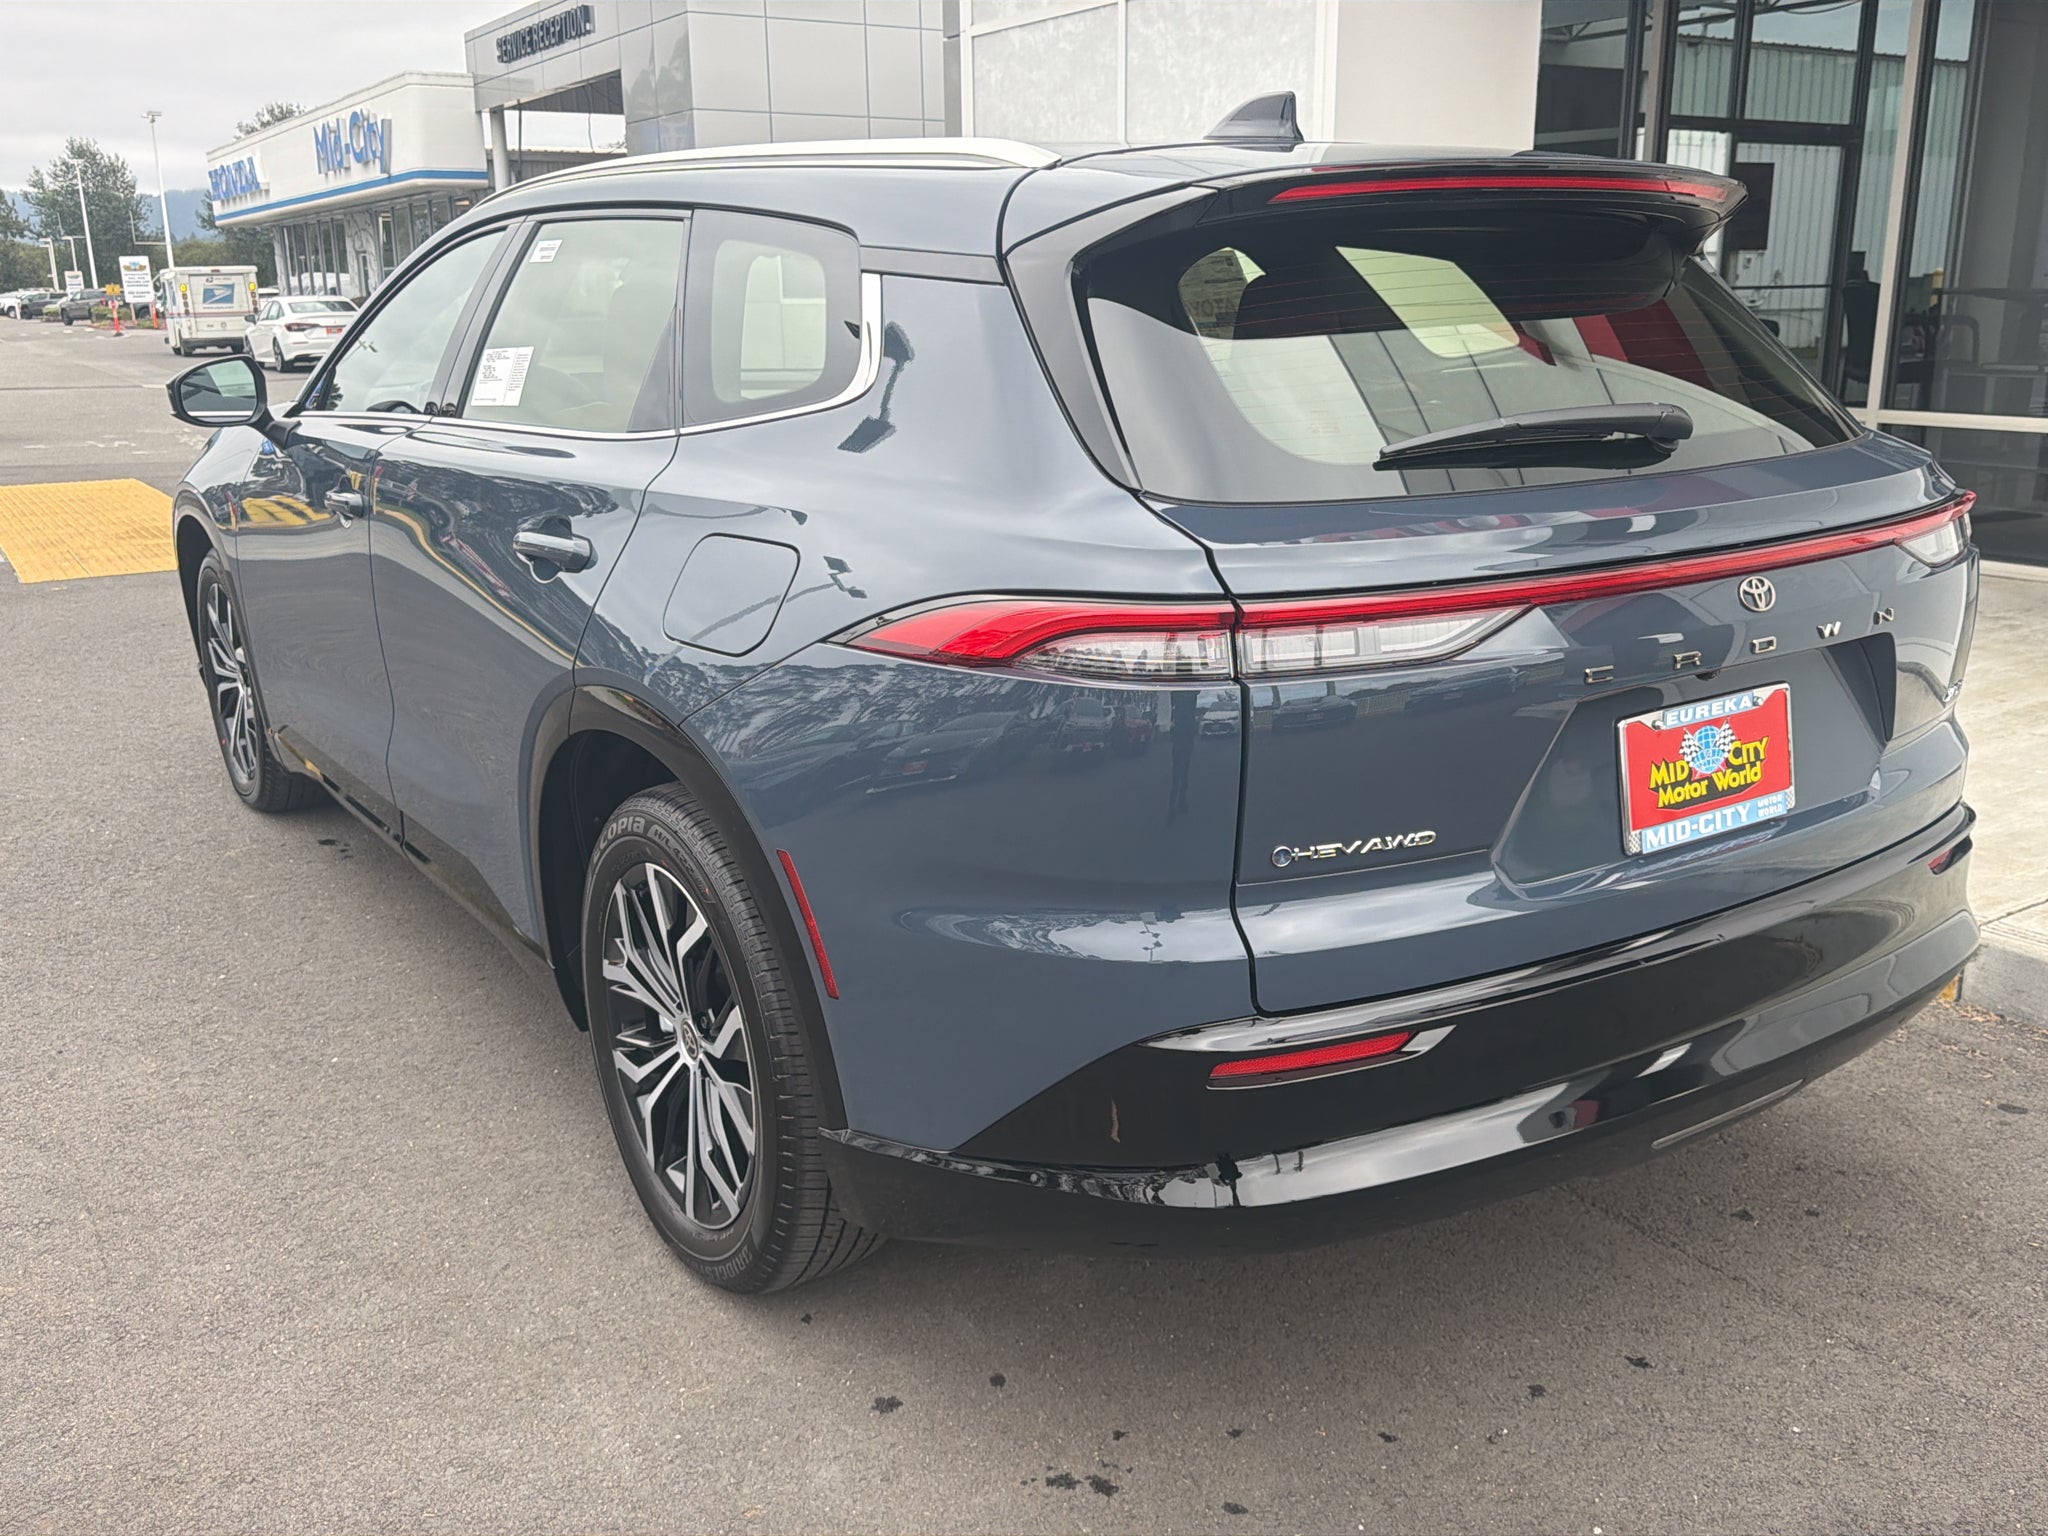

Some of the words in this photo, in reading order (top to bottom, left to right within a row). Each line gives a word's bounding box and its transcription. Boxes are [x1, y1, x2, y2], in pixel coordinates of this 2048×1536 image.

[496, 25, 533, 63] SERVICE
[532, 4, 589, 54] RECEPTION
[313, 107, 388, 175] Mid-City
[207, 155, 261, 202] HONDA
[1667, 694, 1753, 727] EUREKA
[1649, 760, 1690, 789] MID
[1727, 736, 1770, 766] CITY
[1656, 778, 1710, 809] Motor
[1711, 760, 1763, 793] World
[1756, 793, 1784, 809] MOTOR
[1757, 804, 1784, 818] WORLD
[1645, 803, 1752, 850] MID-CITY
